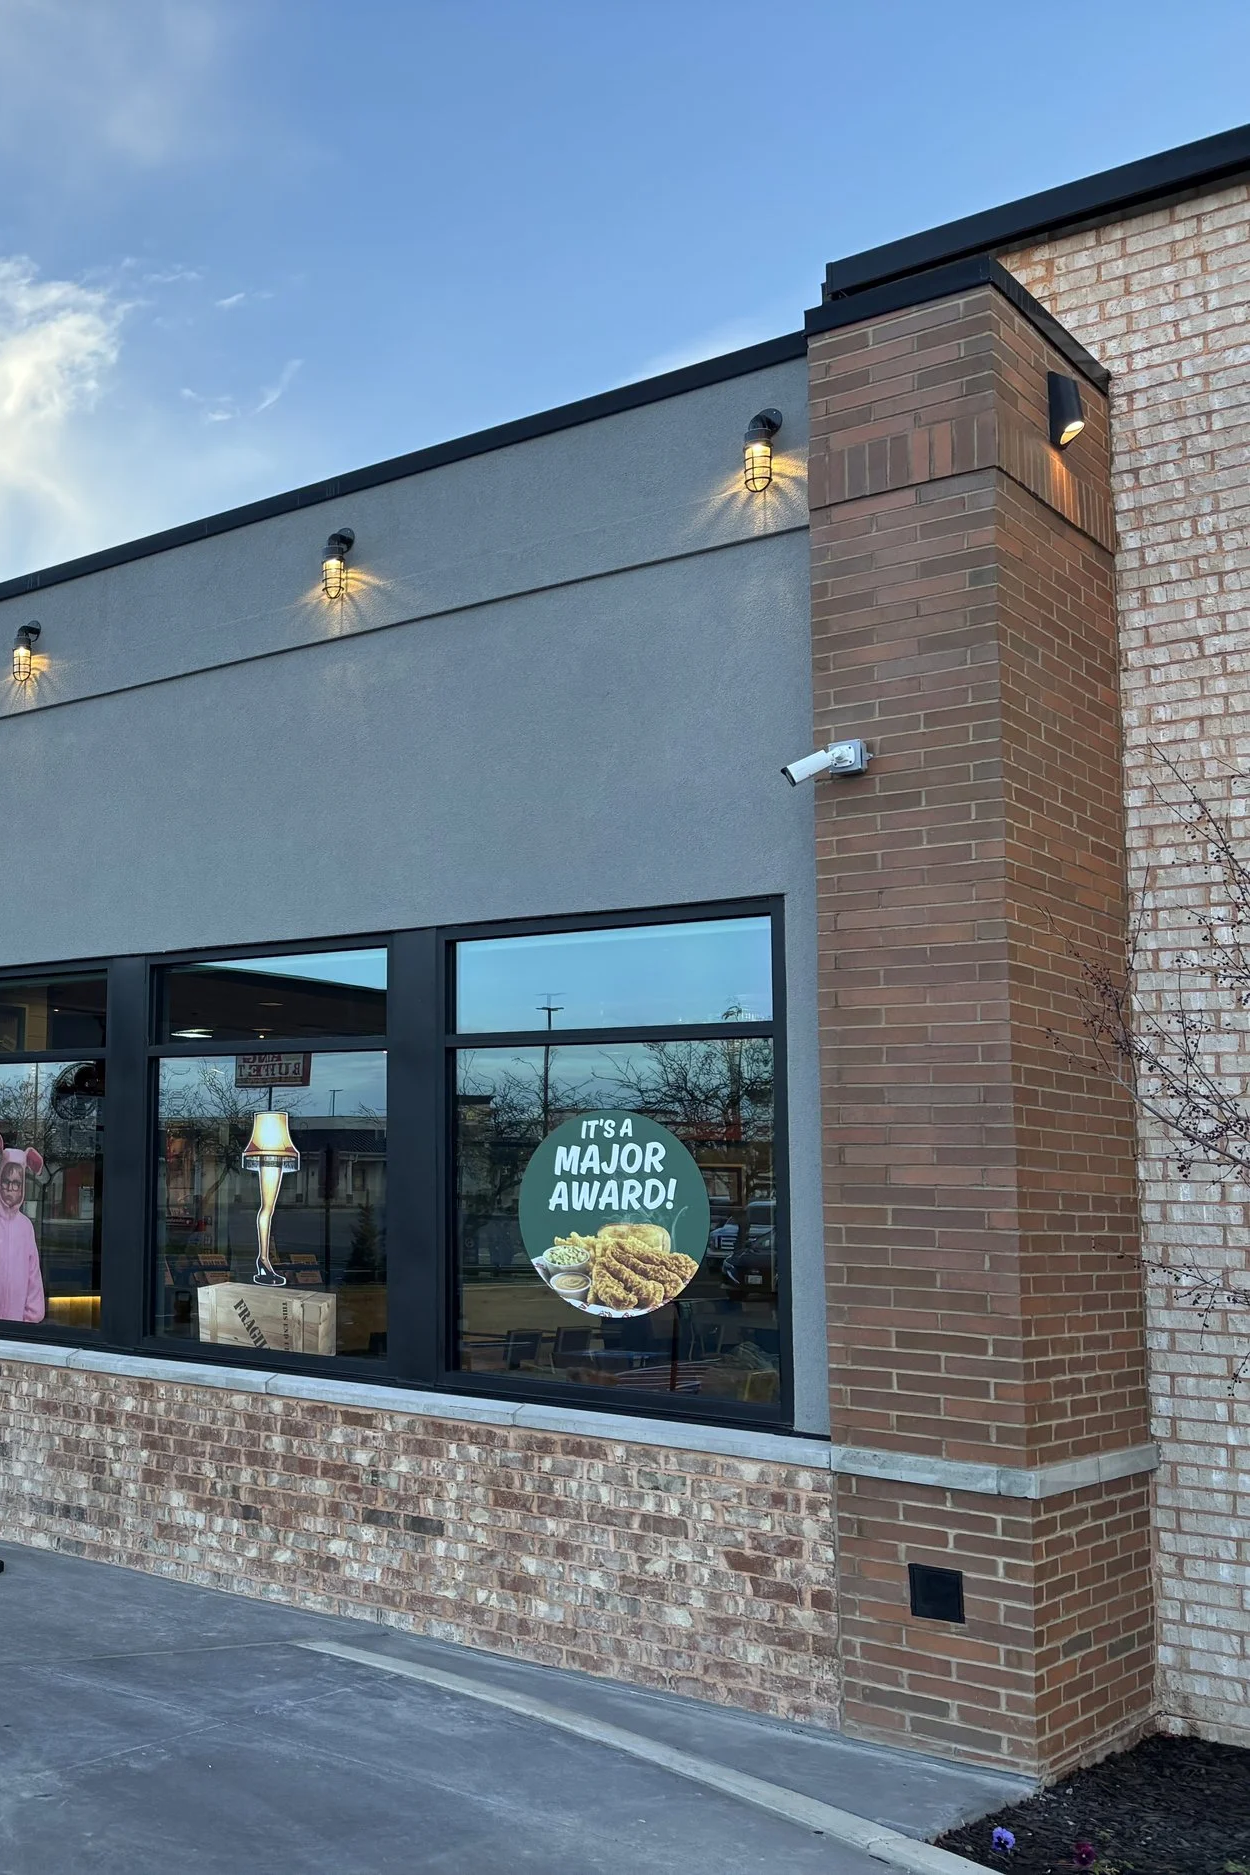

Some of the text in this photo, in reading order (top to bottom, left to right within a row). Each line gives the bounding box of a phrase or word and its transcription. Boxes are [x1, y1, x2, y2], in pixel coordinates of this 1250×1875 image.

[581, 1118, 633, 1139] IT'S A
[554, 1141, 666, 1176] MAJOR
[548, 1178, 677, 1211] AWARD!
[233, 1298, 270, 1349] FRAGIL
